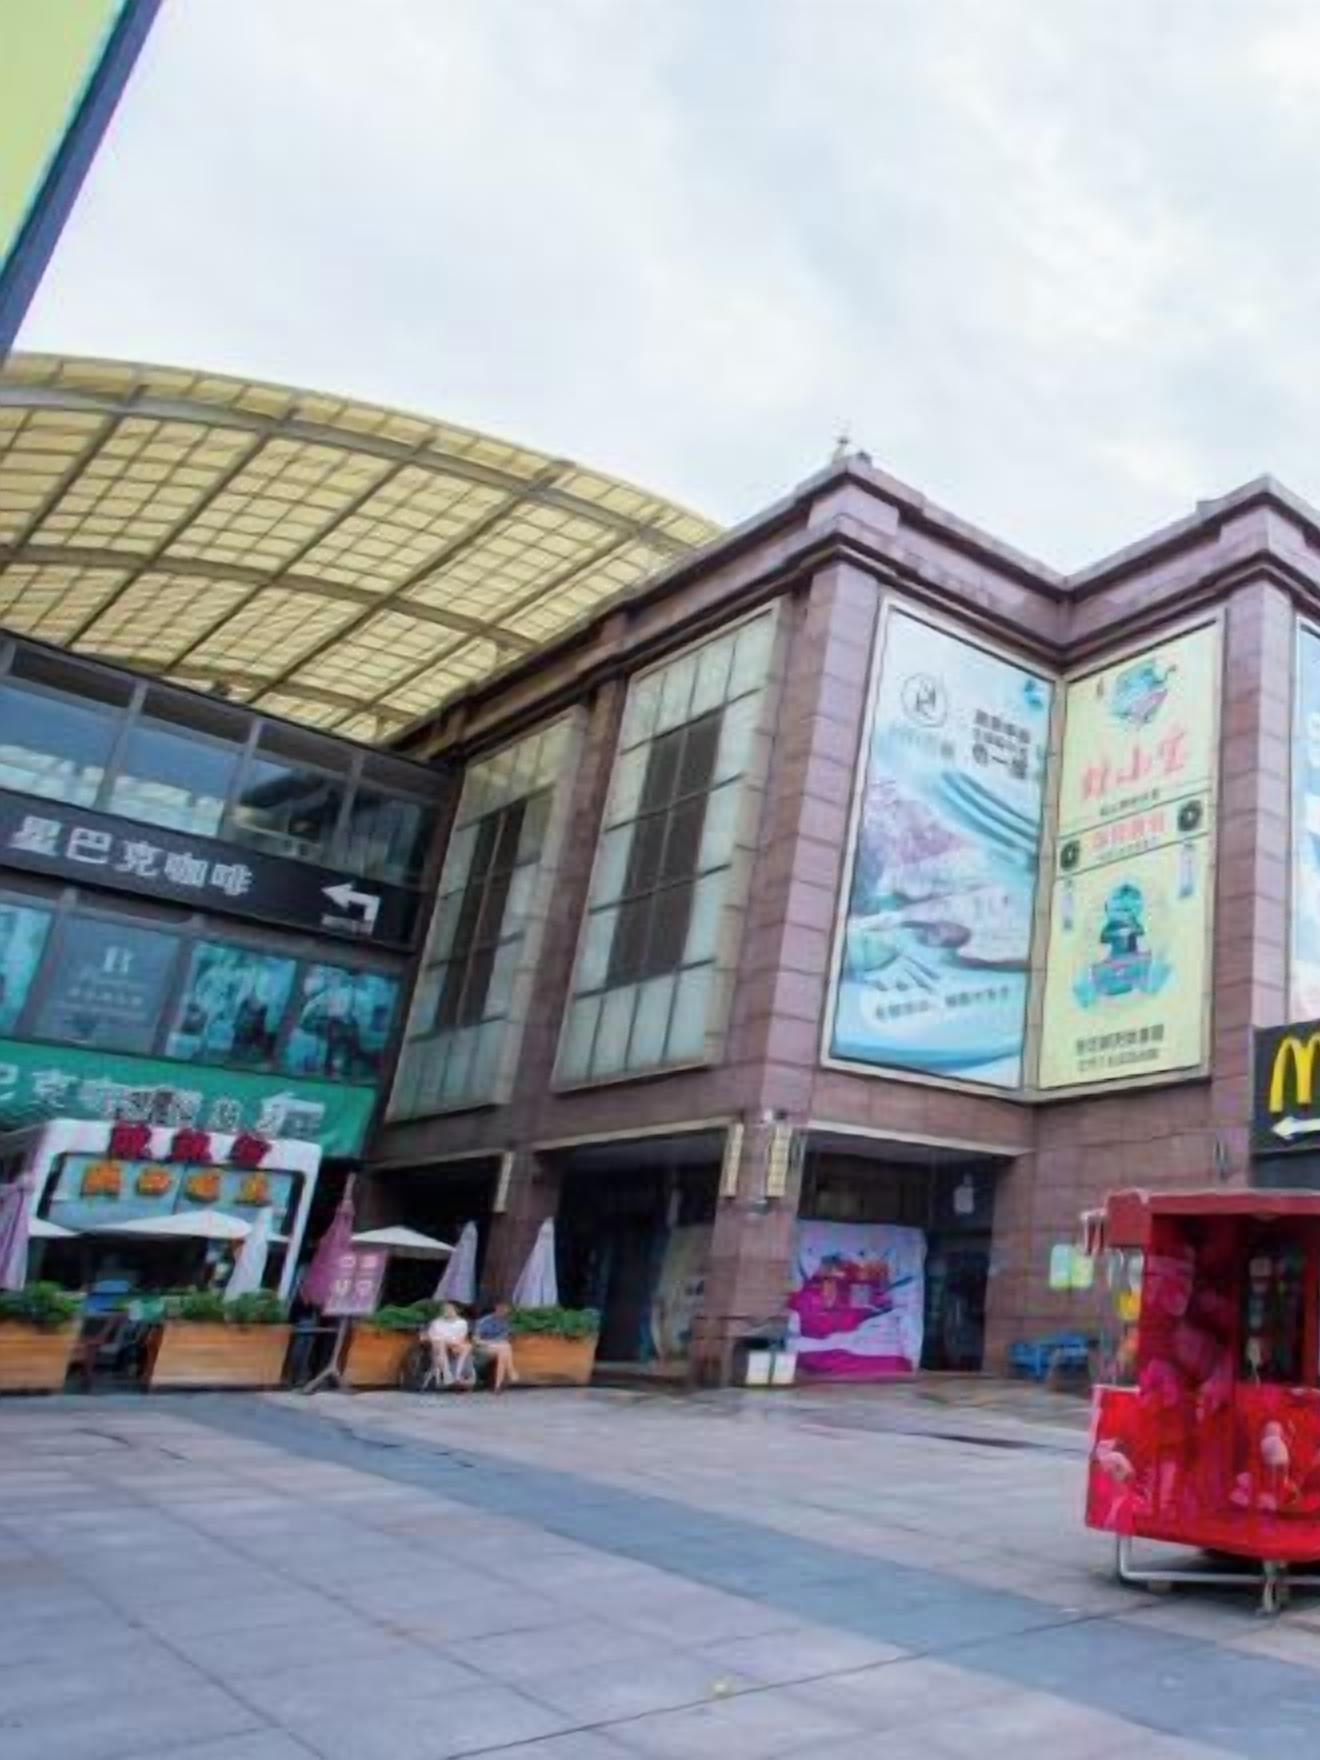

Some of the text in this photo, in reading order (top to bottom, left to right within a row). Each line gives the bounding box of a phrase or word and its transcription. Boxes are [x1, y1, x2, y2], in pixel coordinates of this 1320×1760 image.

[10, 815, 252, 896] 星巴克咖啡
